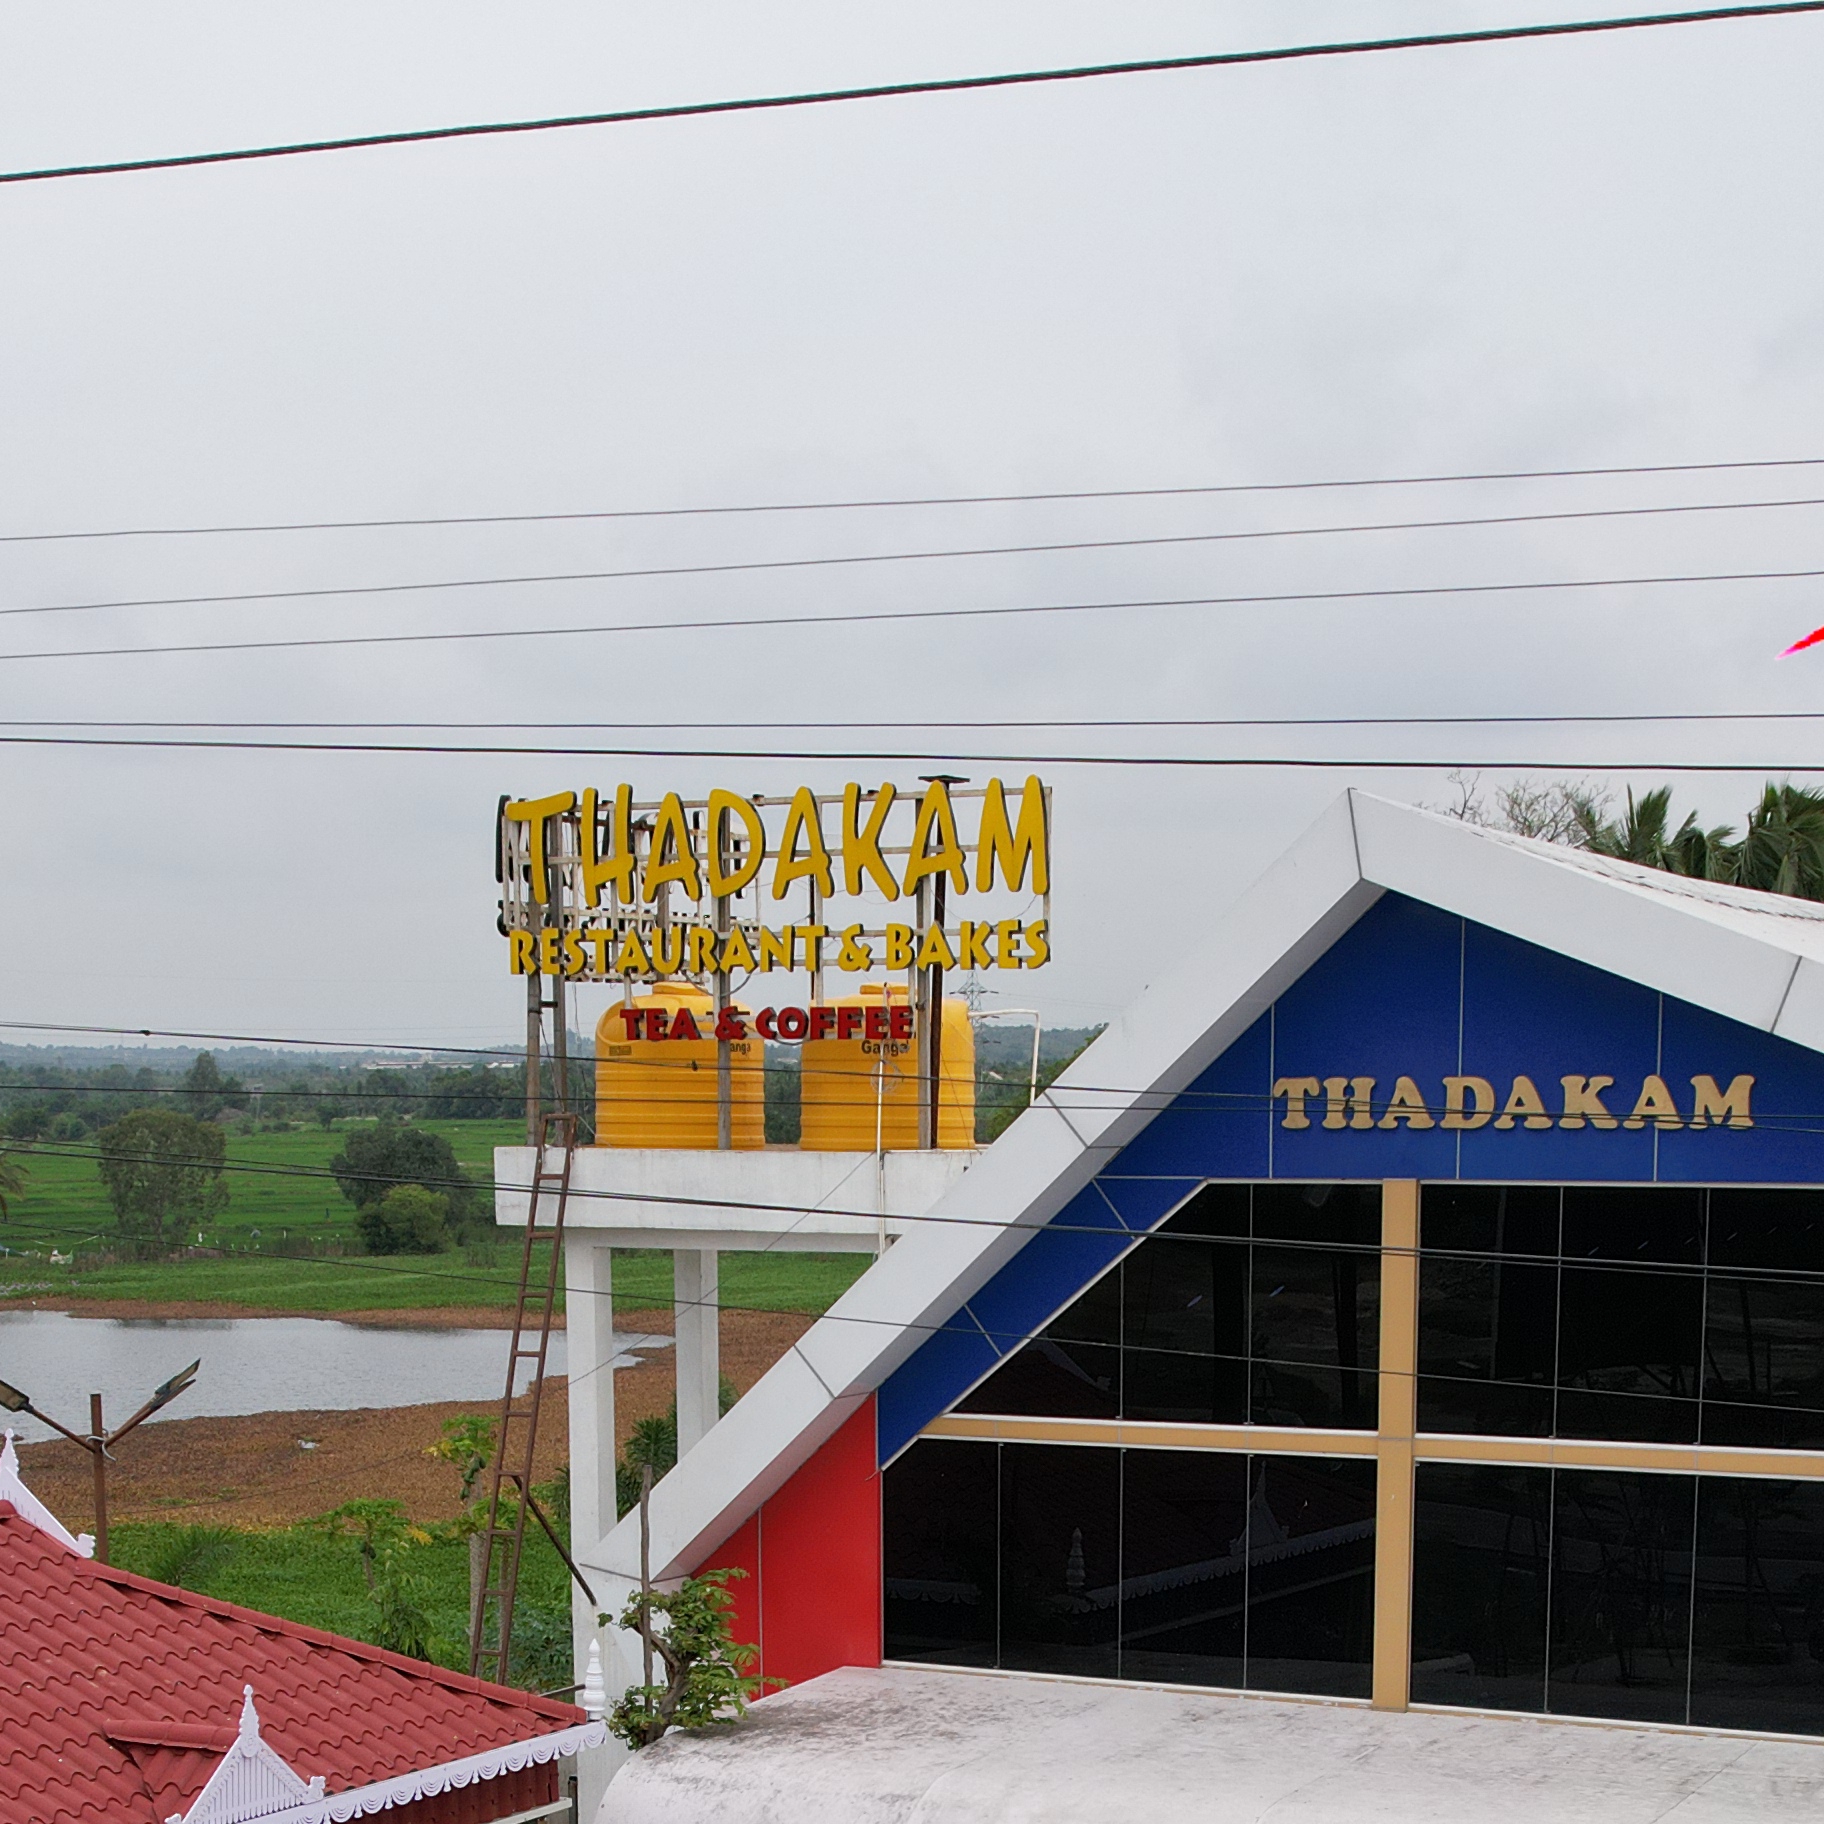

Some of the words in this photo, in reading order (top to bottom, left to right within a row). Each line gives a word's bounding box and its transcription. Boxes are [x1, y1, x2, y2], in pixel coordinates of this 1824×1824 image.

[506, 775, 1051, 908] THADAKAM
[508, 924, 829, 976] RESTAURANT
[837, 924, 873, 972] &
[885, 919, 1050, 971] BAKES
[620, 1006, 702, 1041] TEA
[714, 1005, 750, 1041] &
[755, 1005, 914, 1041] COFFEE
[1272, 1074, 1756, 1130] THADAKAM
